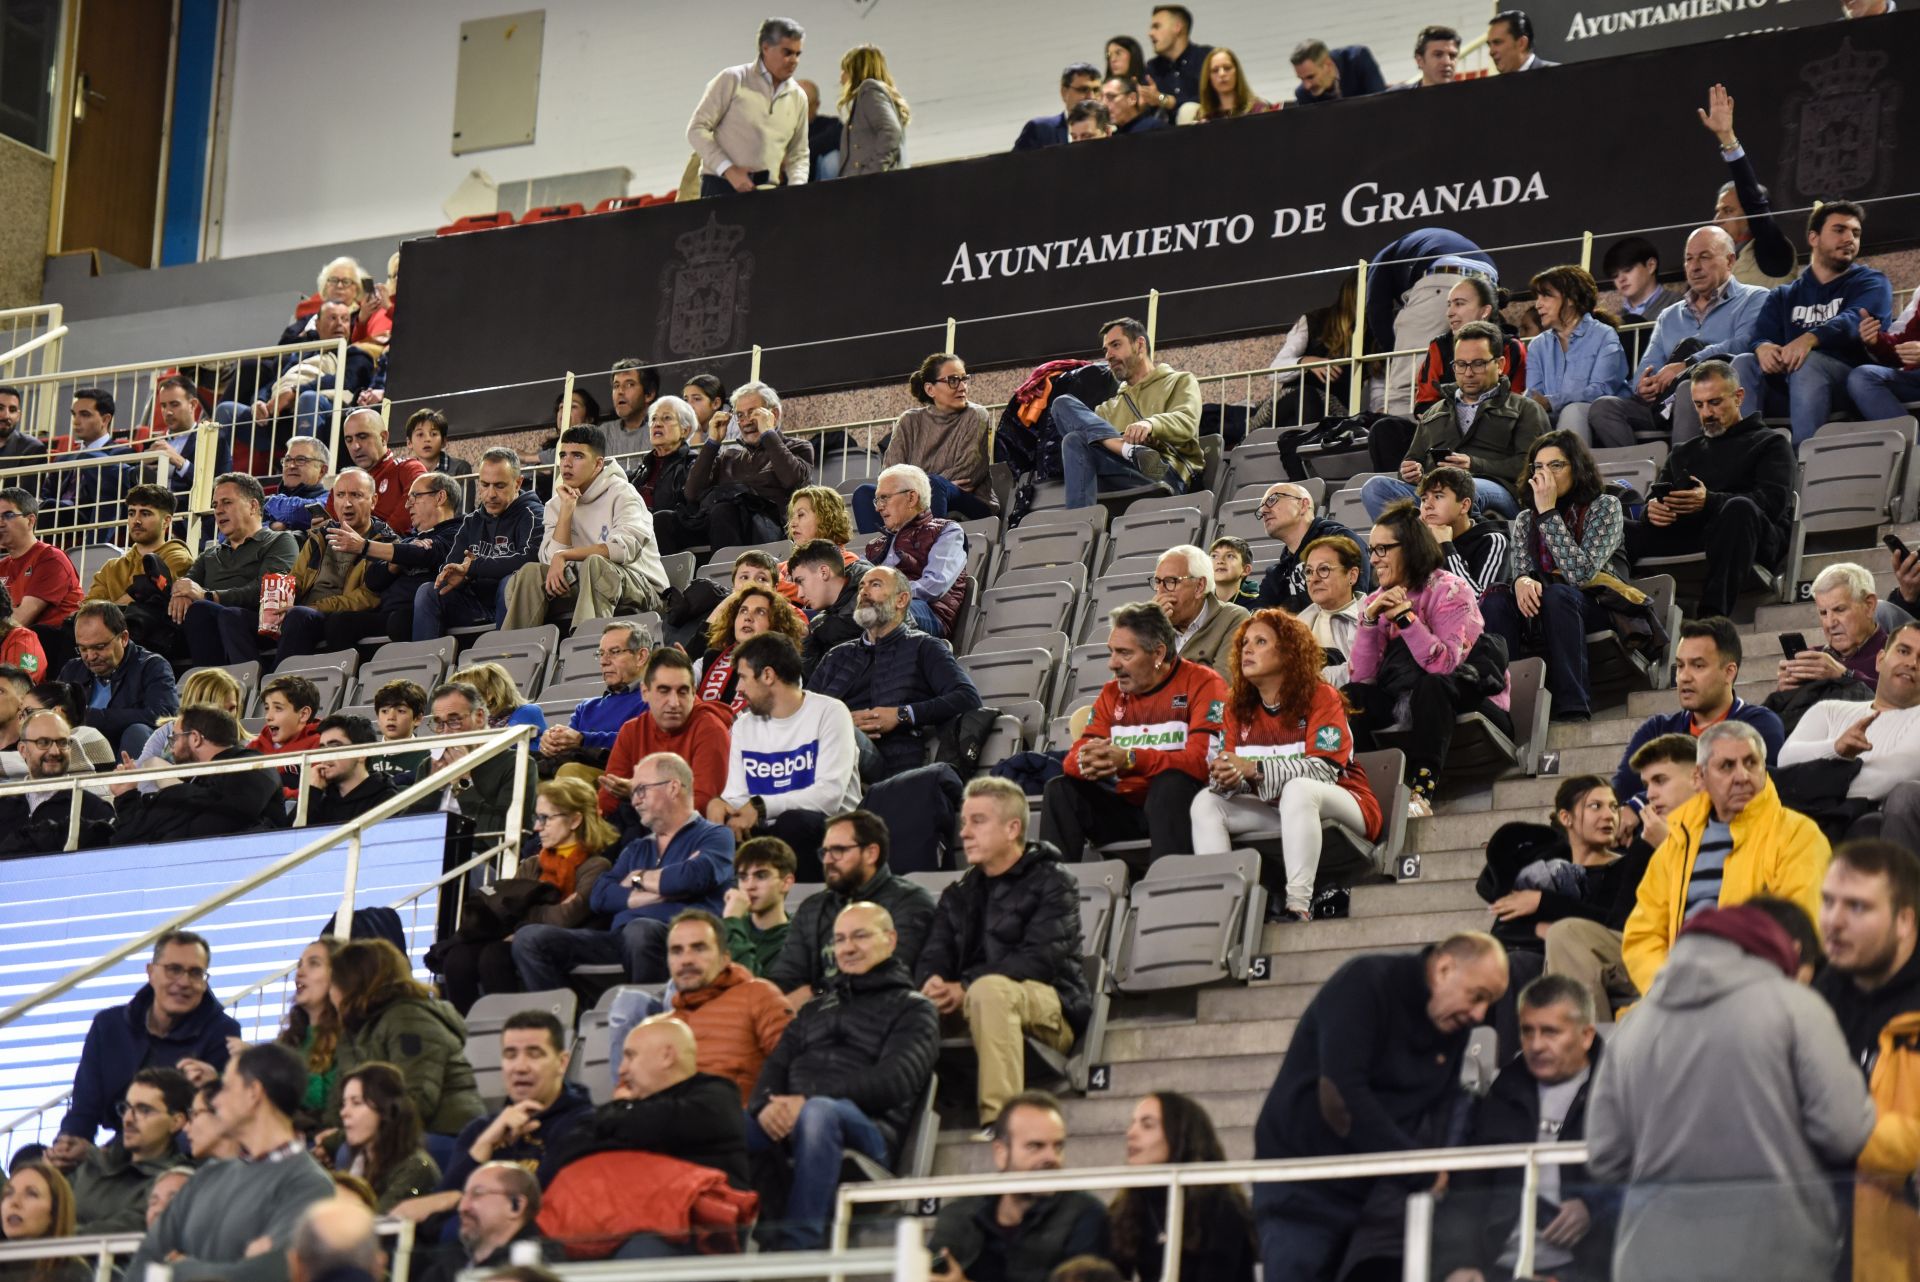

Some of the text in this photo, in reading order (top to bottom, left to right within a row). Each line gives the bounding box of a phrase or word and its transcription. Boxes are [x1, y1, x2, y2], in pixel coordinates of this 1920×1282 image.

[942, 170, 1550, 285] AYUNTAMIENTO DE GRANADA
[1801, 583, 1812, 599] 9
[742, 750, 815, 778] Reebok
[1543, 755, 1555, 772] 7
[1403, 858, 1416, 876] 6
[1253, 958, 1266, 977] 5
[1092, 1069, 1106, 1088] 4
[922, 1196, 936, 1214] 3
